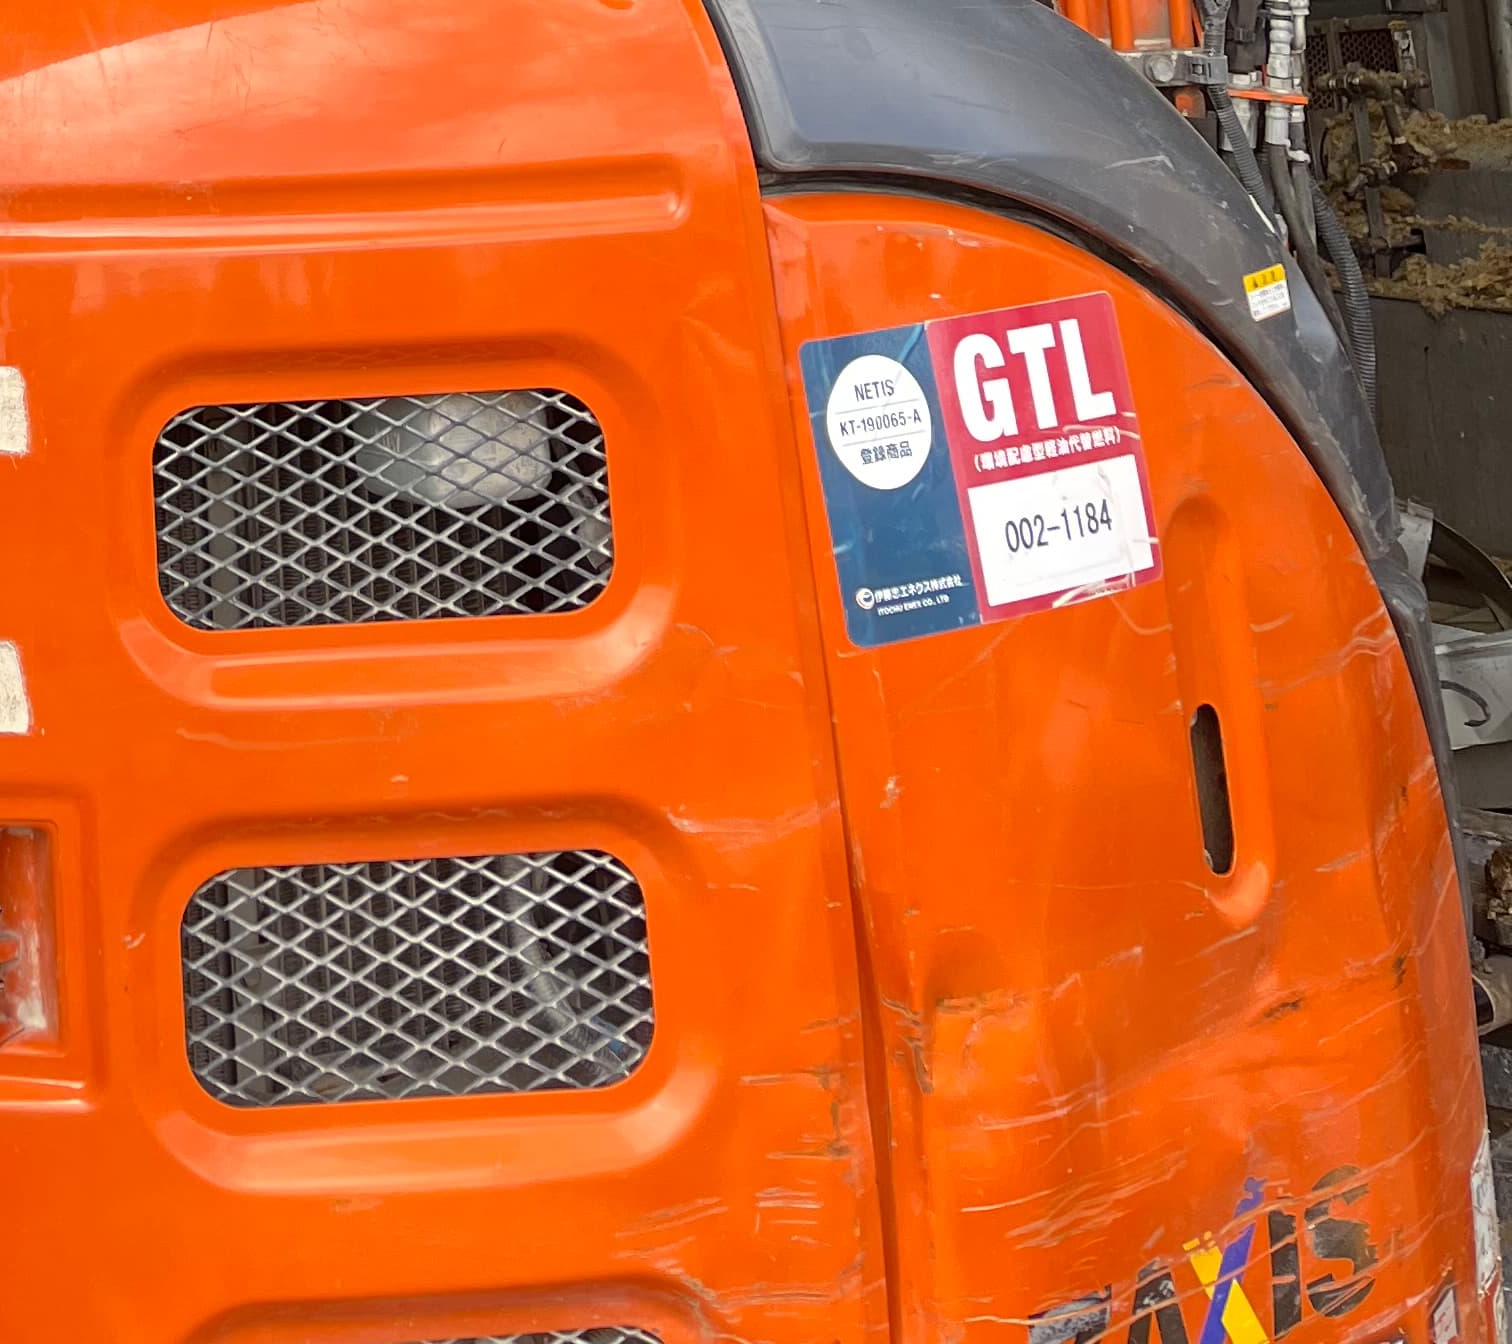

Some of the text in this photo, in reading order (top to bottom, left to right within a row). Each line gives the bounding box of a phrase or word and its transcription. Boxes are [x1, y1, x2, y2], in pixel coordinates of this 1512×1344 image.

[854, 379, 895, 402] NETIS
[953, 318, 1117, 443] GTL
[839, 408, 922, 437] KT-190065-A
[860, 441, 913, 465] 登録商品
[1005, 499, 1113, 553] 002-1184
